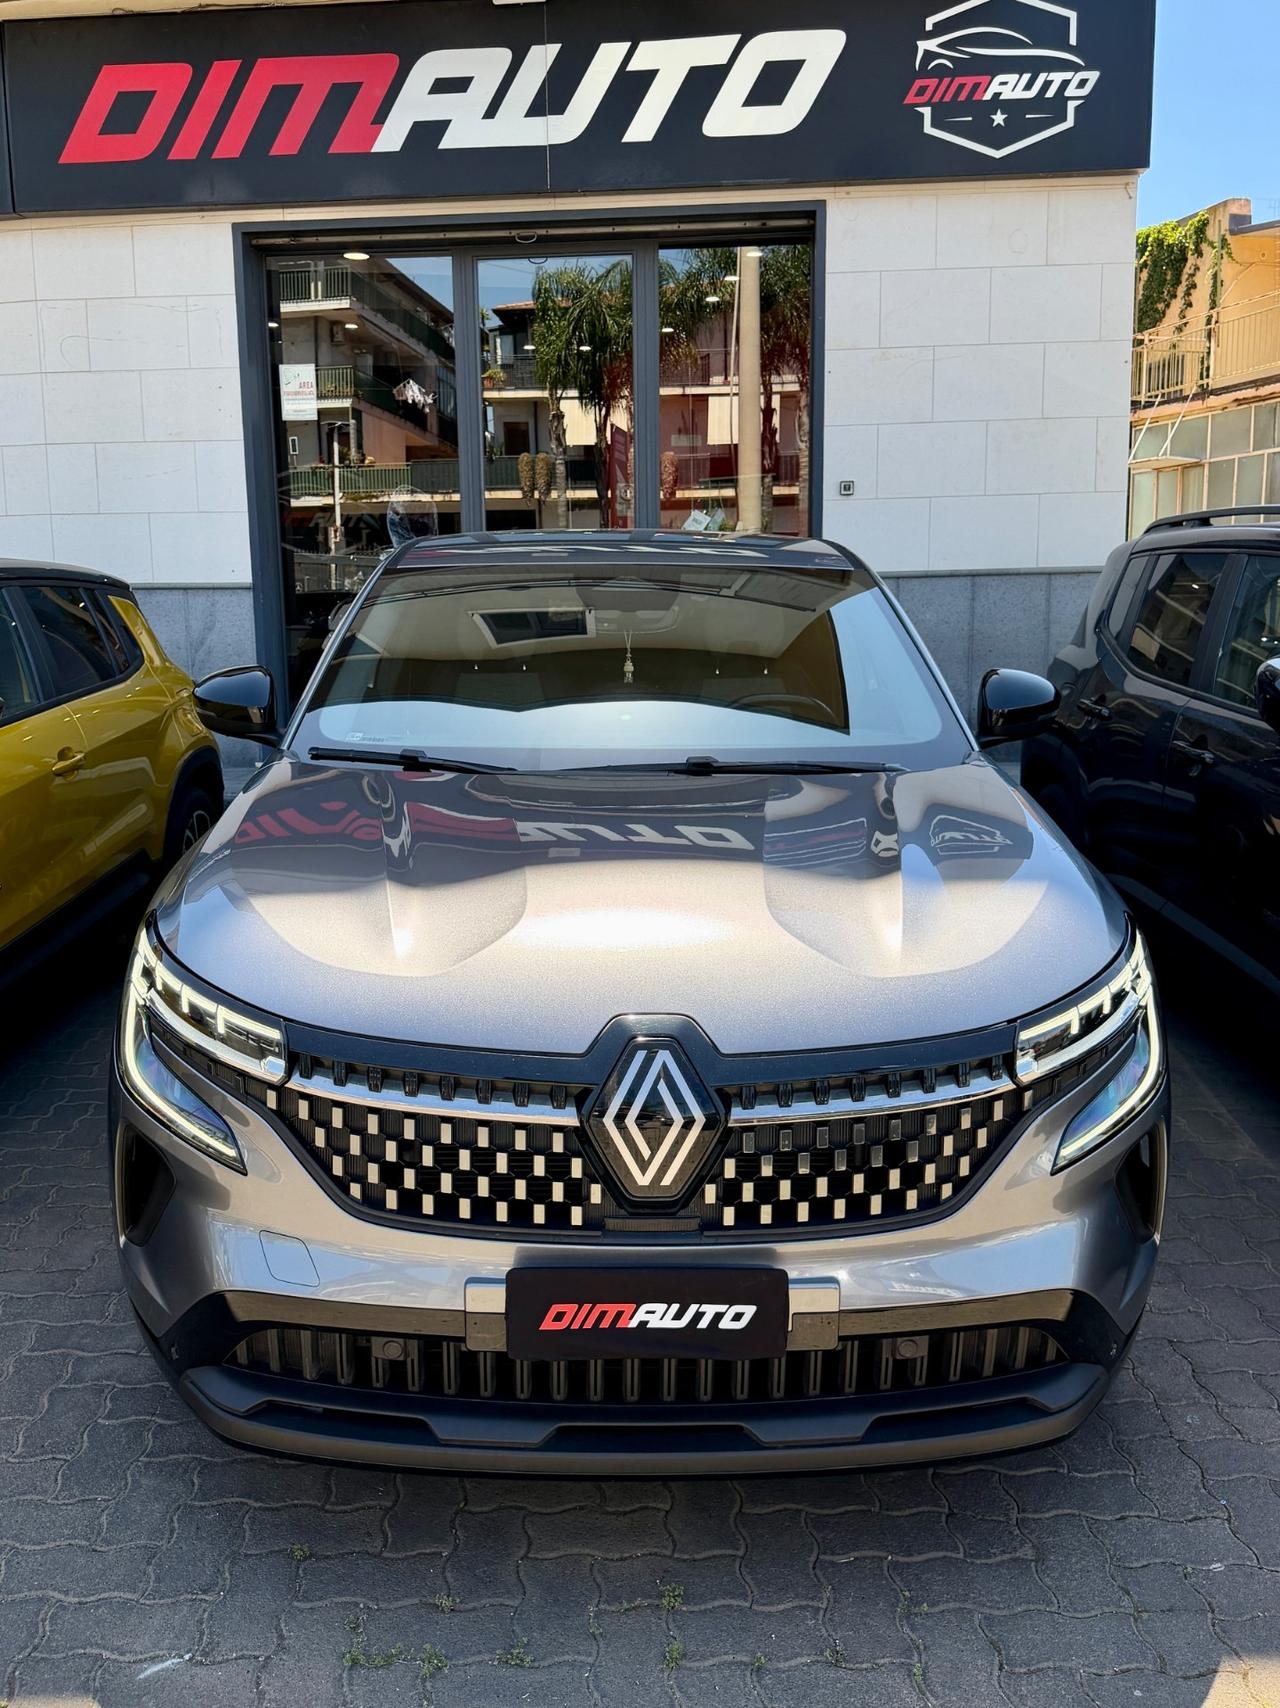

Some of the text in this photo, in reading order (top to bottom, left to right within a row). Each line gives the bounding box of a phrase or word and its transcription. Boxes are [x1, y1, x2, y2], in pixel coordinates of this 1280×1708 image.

[58, 29, 847, 164] DIMAUTO
[902, 71, 1100, 104] DIMAUTO
[538, 1303, 758, 1330] DIMAUTO
